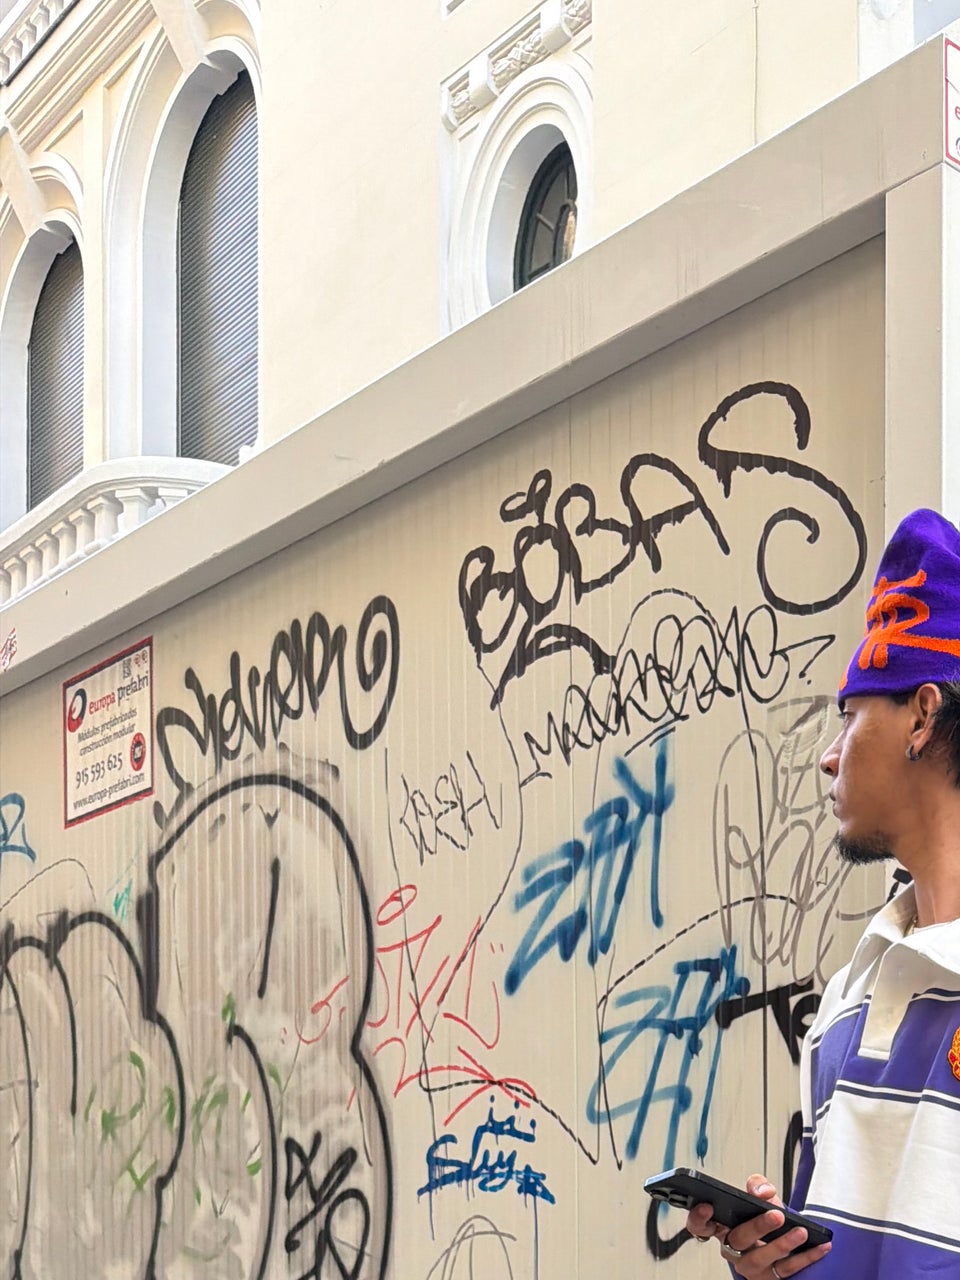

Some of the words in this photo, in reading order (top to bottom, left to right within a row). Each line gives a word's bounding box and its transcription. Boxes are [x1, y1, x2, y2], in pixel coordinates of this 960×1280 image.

[88, 691, 116, 715] europa
[117, 671, 149, 706] prefabri
[75, 767, 89, 789] 915
[90, 760, 106, 784] 593
[106, 752, 123, 772] 625
[73, 771, 145, 811] www.europa-prefabri.com
